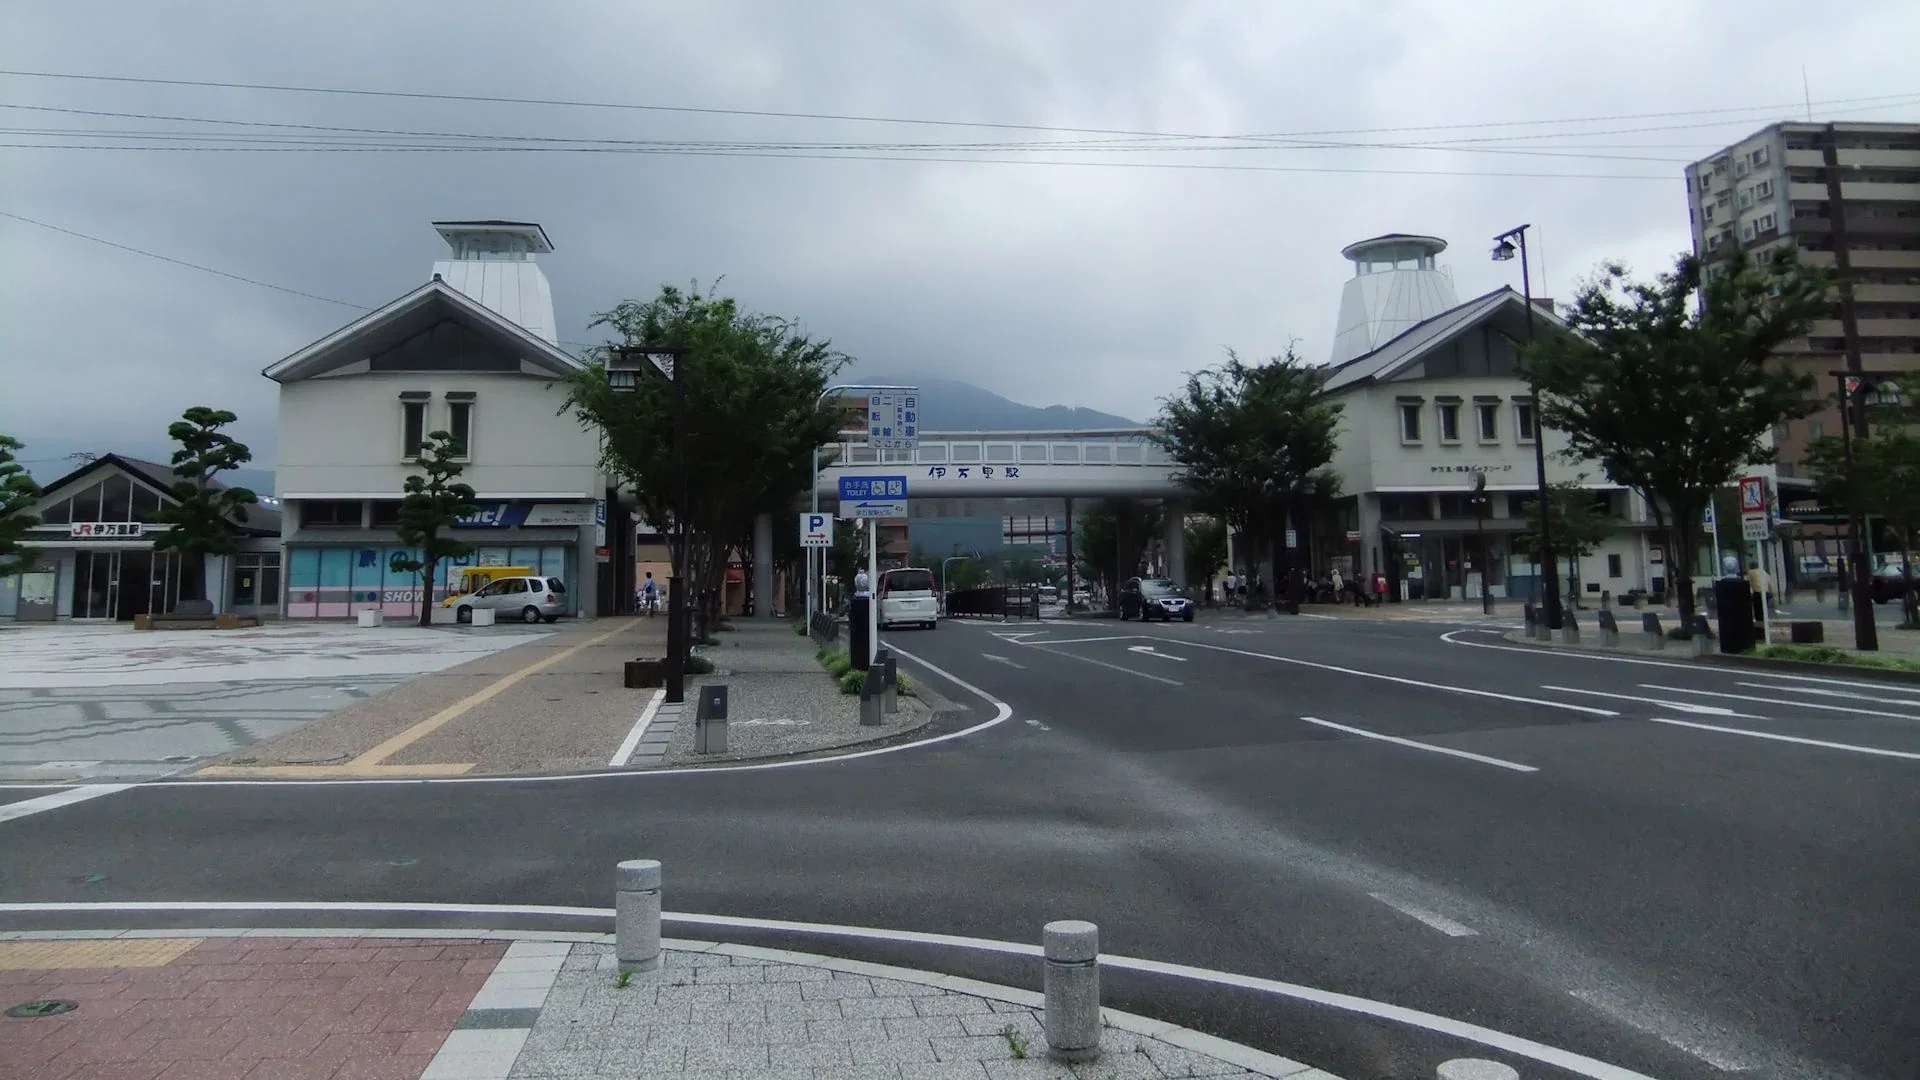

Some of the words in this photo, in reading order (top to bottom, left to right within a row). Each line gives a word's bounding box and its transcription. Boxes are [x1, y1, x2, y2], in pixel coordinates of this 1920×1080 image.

[872, 396, 880, 436] 自転車
[905, 397, 916, 437] 自動車
[875, 440, 912, 448] ここから
[928, 466, 1020, 480] 伊万里駅
[73, 524, 92, 535] JR
[94, 524, 139, 535] 伊万里駅
[809, 515, 824, 532] P
